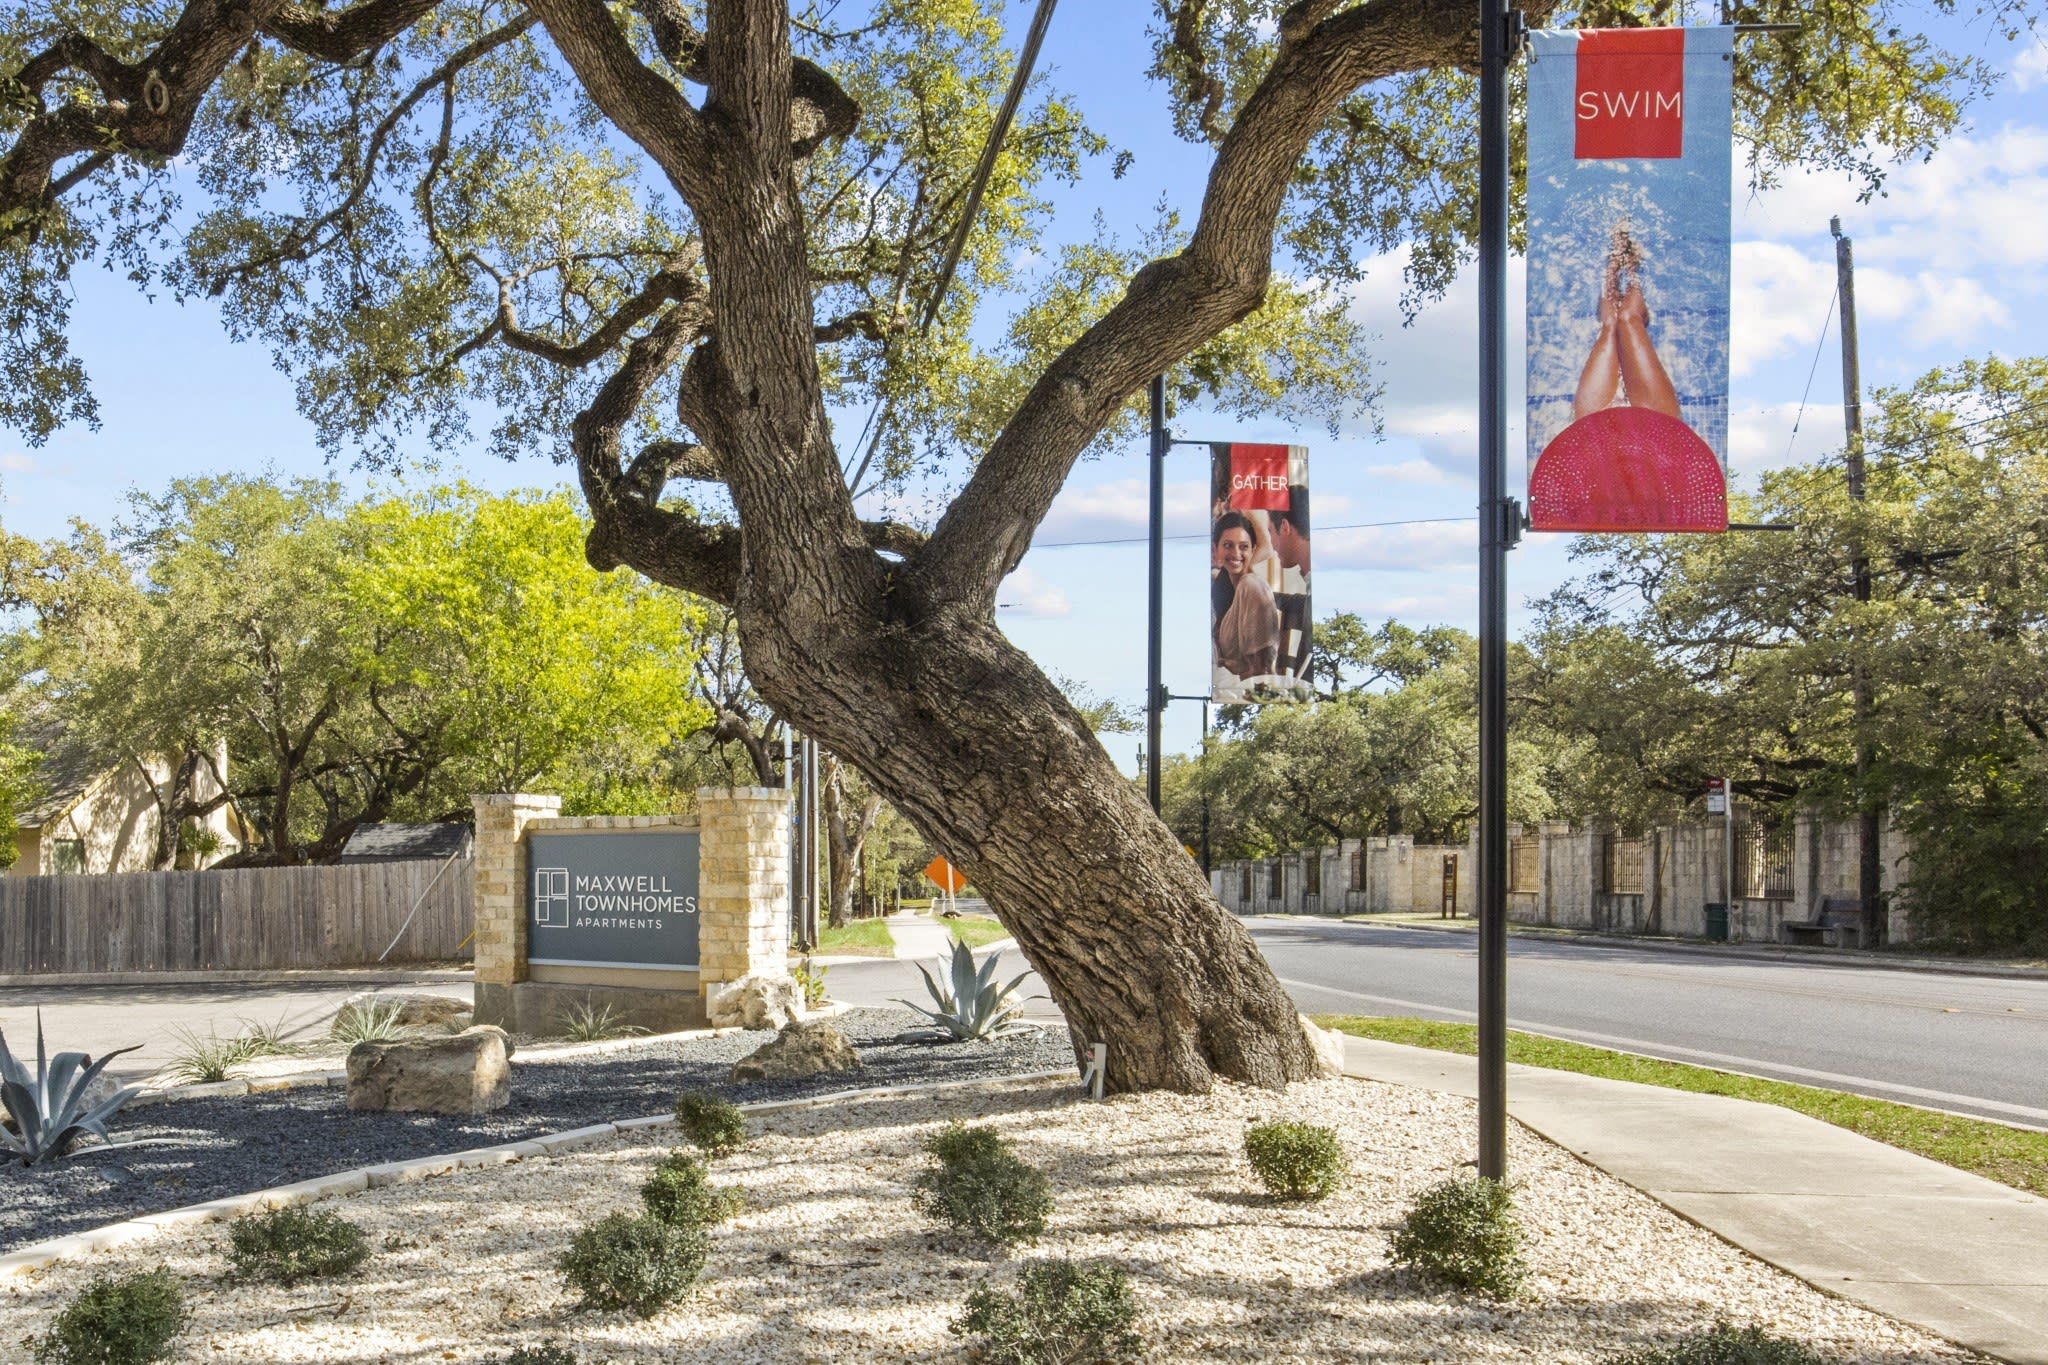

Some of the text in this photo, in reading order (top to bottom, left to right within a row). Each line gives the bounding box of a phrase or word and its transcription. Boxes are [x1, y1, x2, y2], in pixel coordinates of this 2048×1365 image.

[1578, 91, 1681, 120] SWIM
[1232, 473, 1289, 491] GATHER
[575, 875, 673, 893] MAXWELL
[575, 894, 696, 913] TOWNHOMES
[575, 917, 663, 930] APARTMENTS
